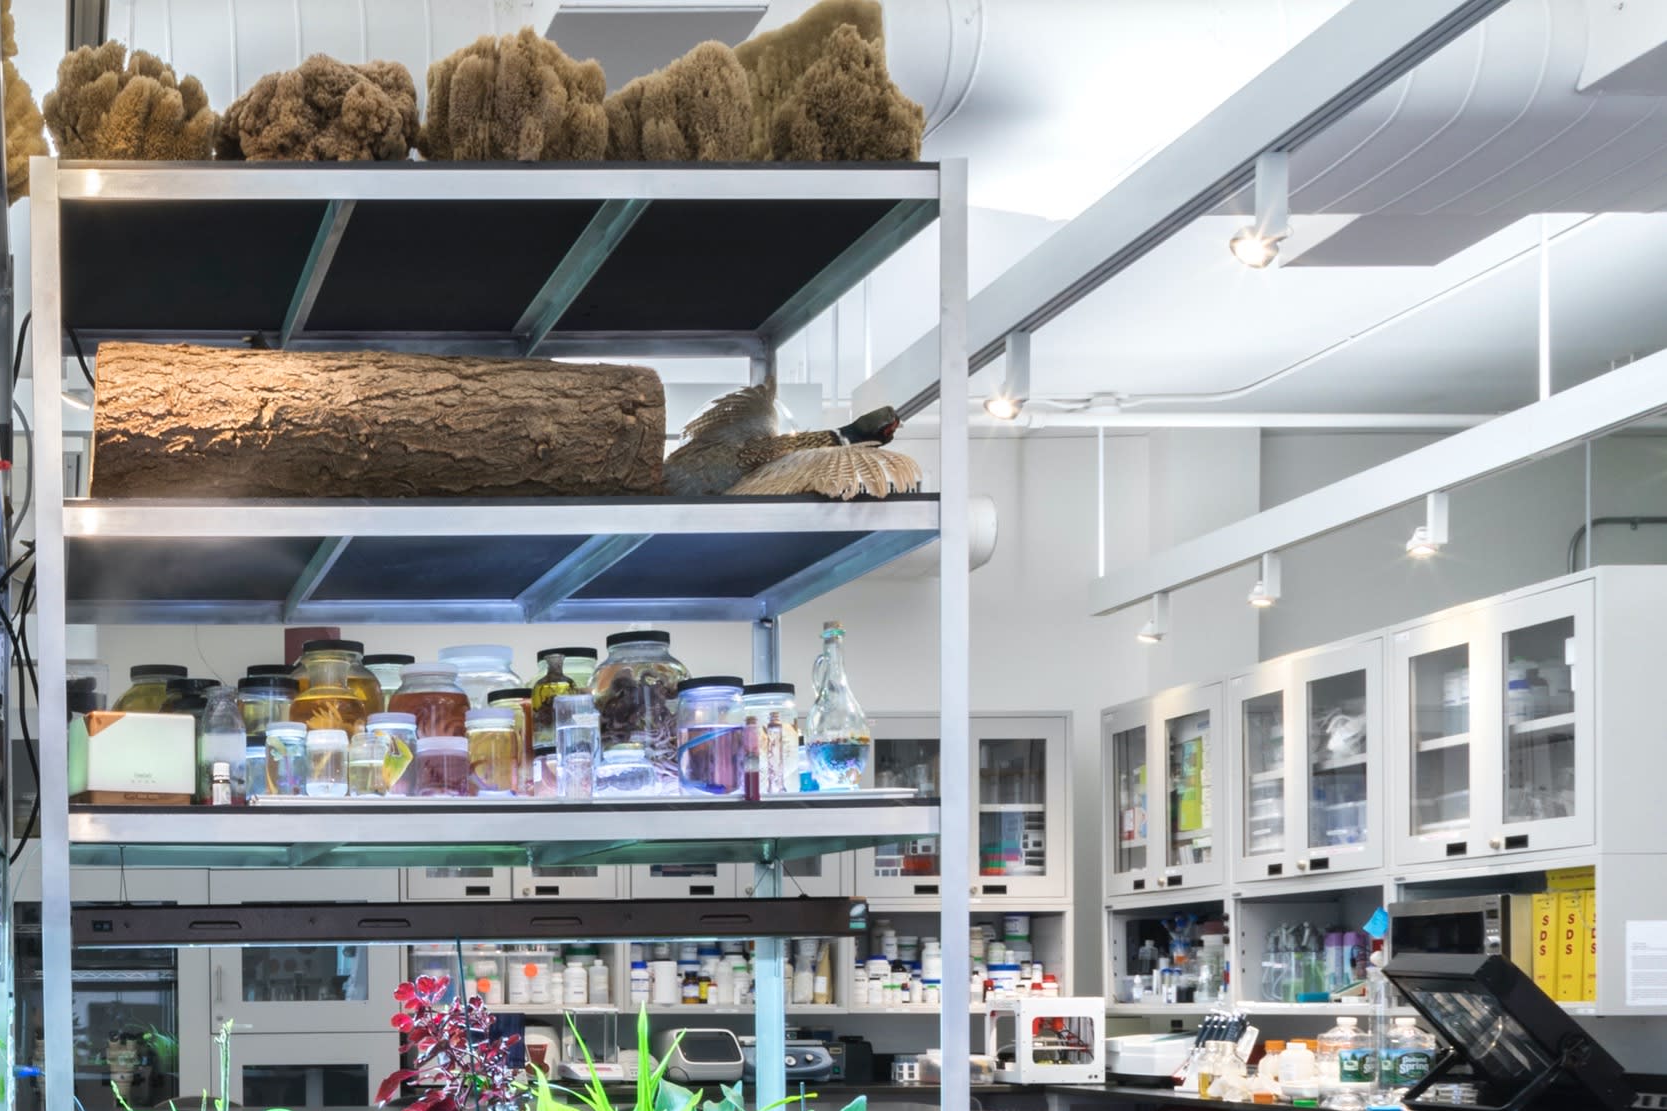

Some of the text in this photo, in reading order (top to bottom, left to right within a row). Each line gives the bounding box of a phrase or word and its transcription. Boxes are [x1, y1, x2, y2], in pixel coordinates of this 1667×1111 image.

[1539, 915, 1549, 956] SDS
[1565, 913, 1575, 955] SDS
[1398, 1063, 1430, 1075] Spring
